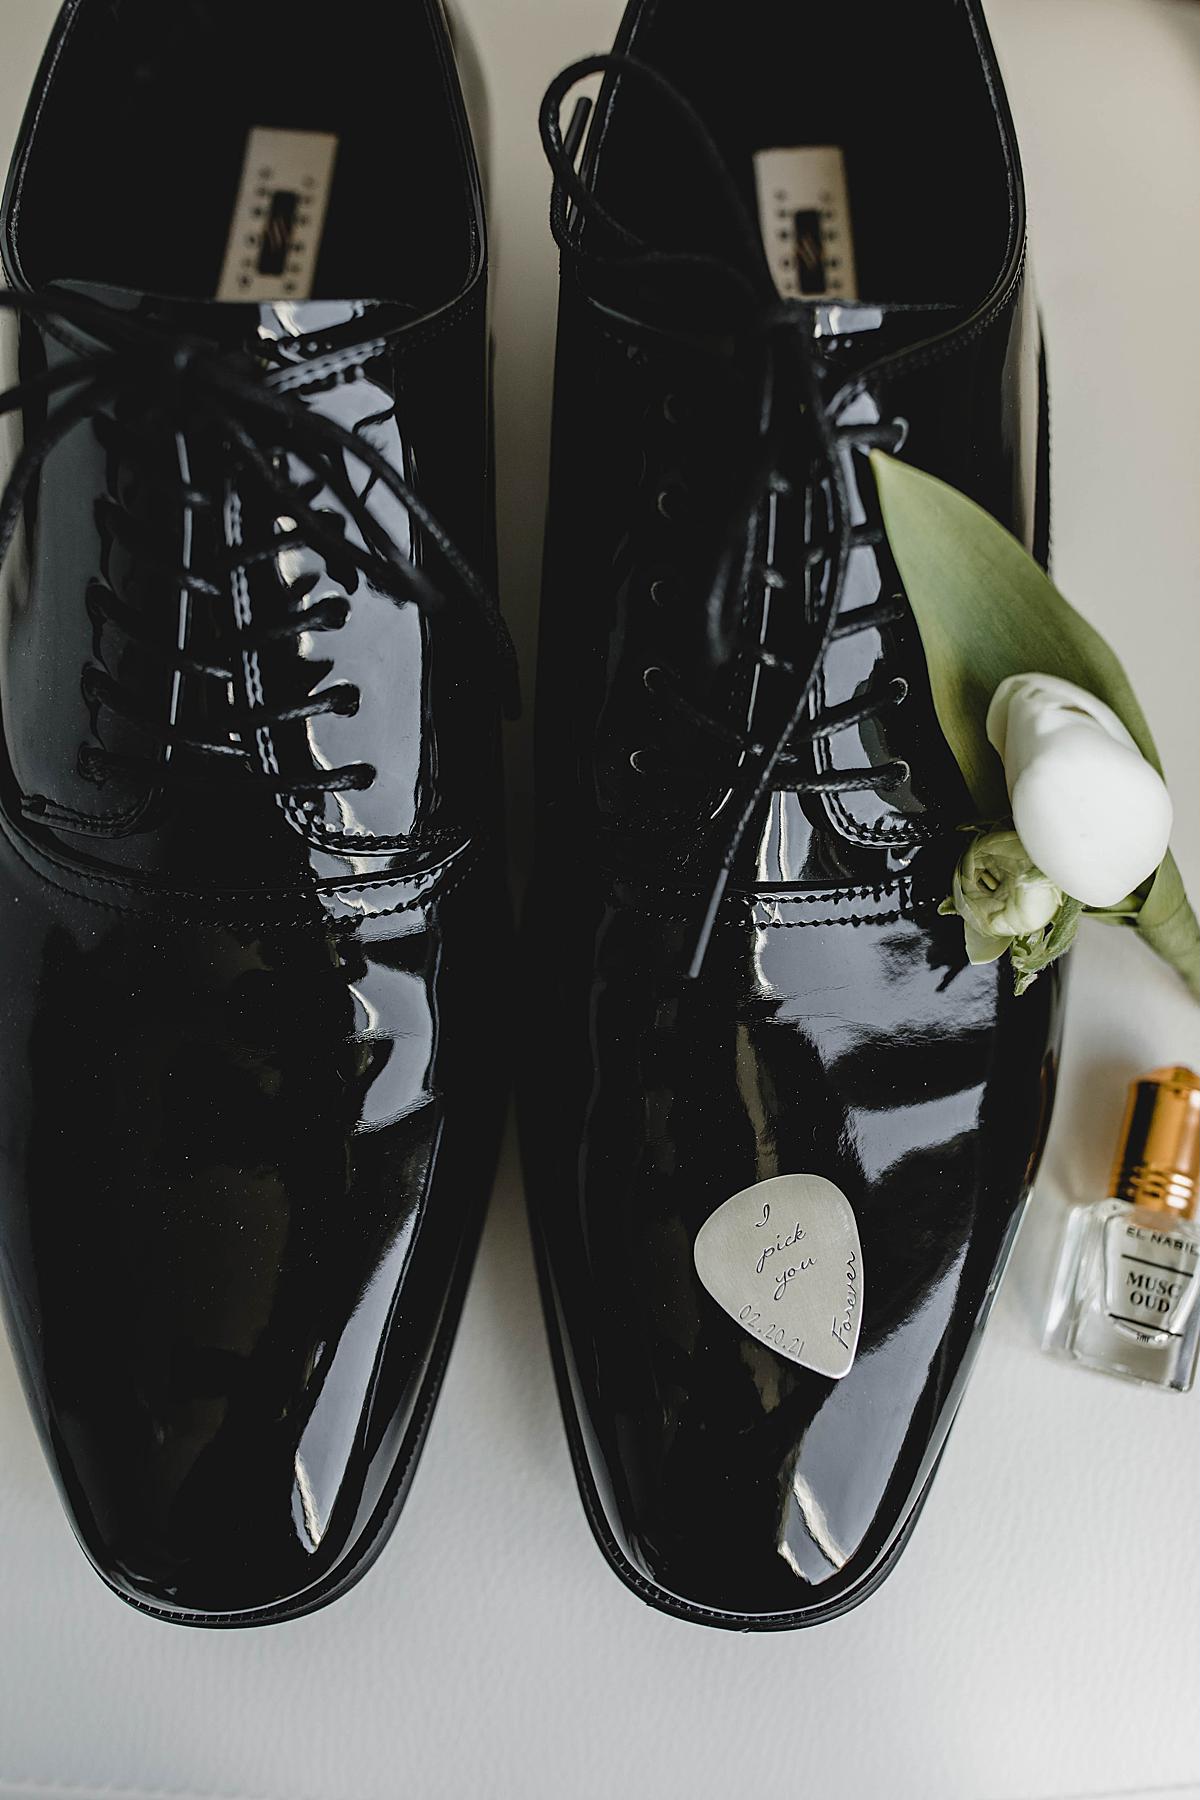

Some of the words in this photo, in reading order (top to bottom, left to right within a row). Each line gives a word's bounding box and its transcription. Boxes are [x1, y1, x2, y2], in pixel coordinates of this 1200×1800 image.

[754, 1202, 770, 1228] I
[1126, 1226, 1144, 1240] EL
[756, 1222, 806, 1274] pick
[773, 1256, 817, 1301] you
[831, 1251, 856, 1350] Forever
[1130, 1290, 1170, 1313] OUD
[739, 1304, 806, 1358] 02.20.21
